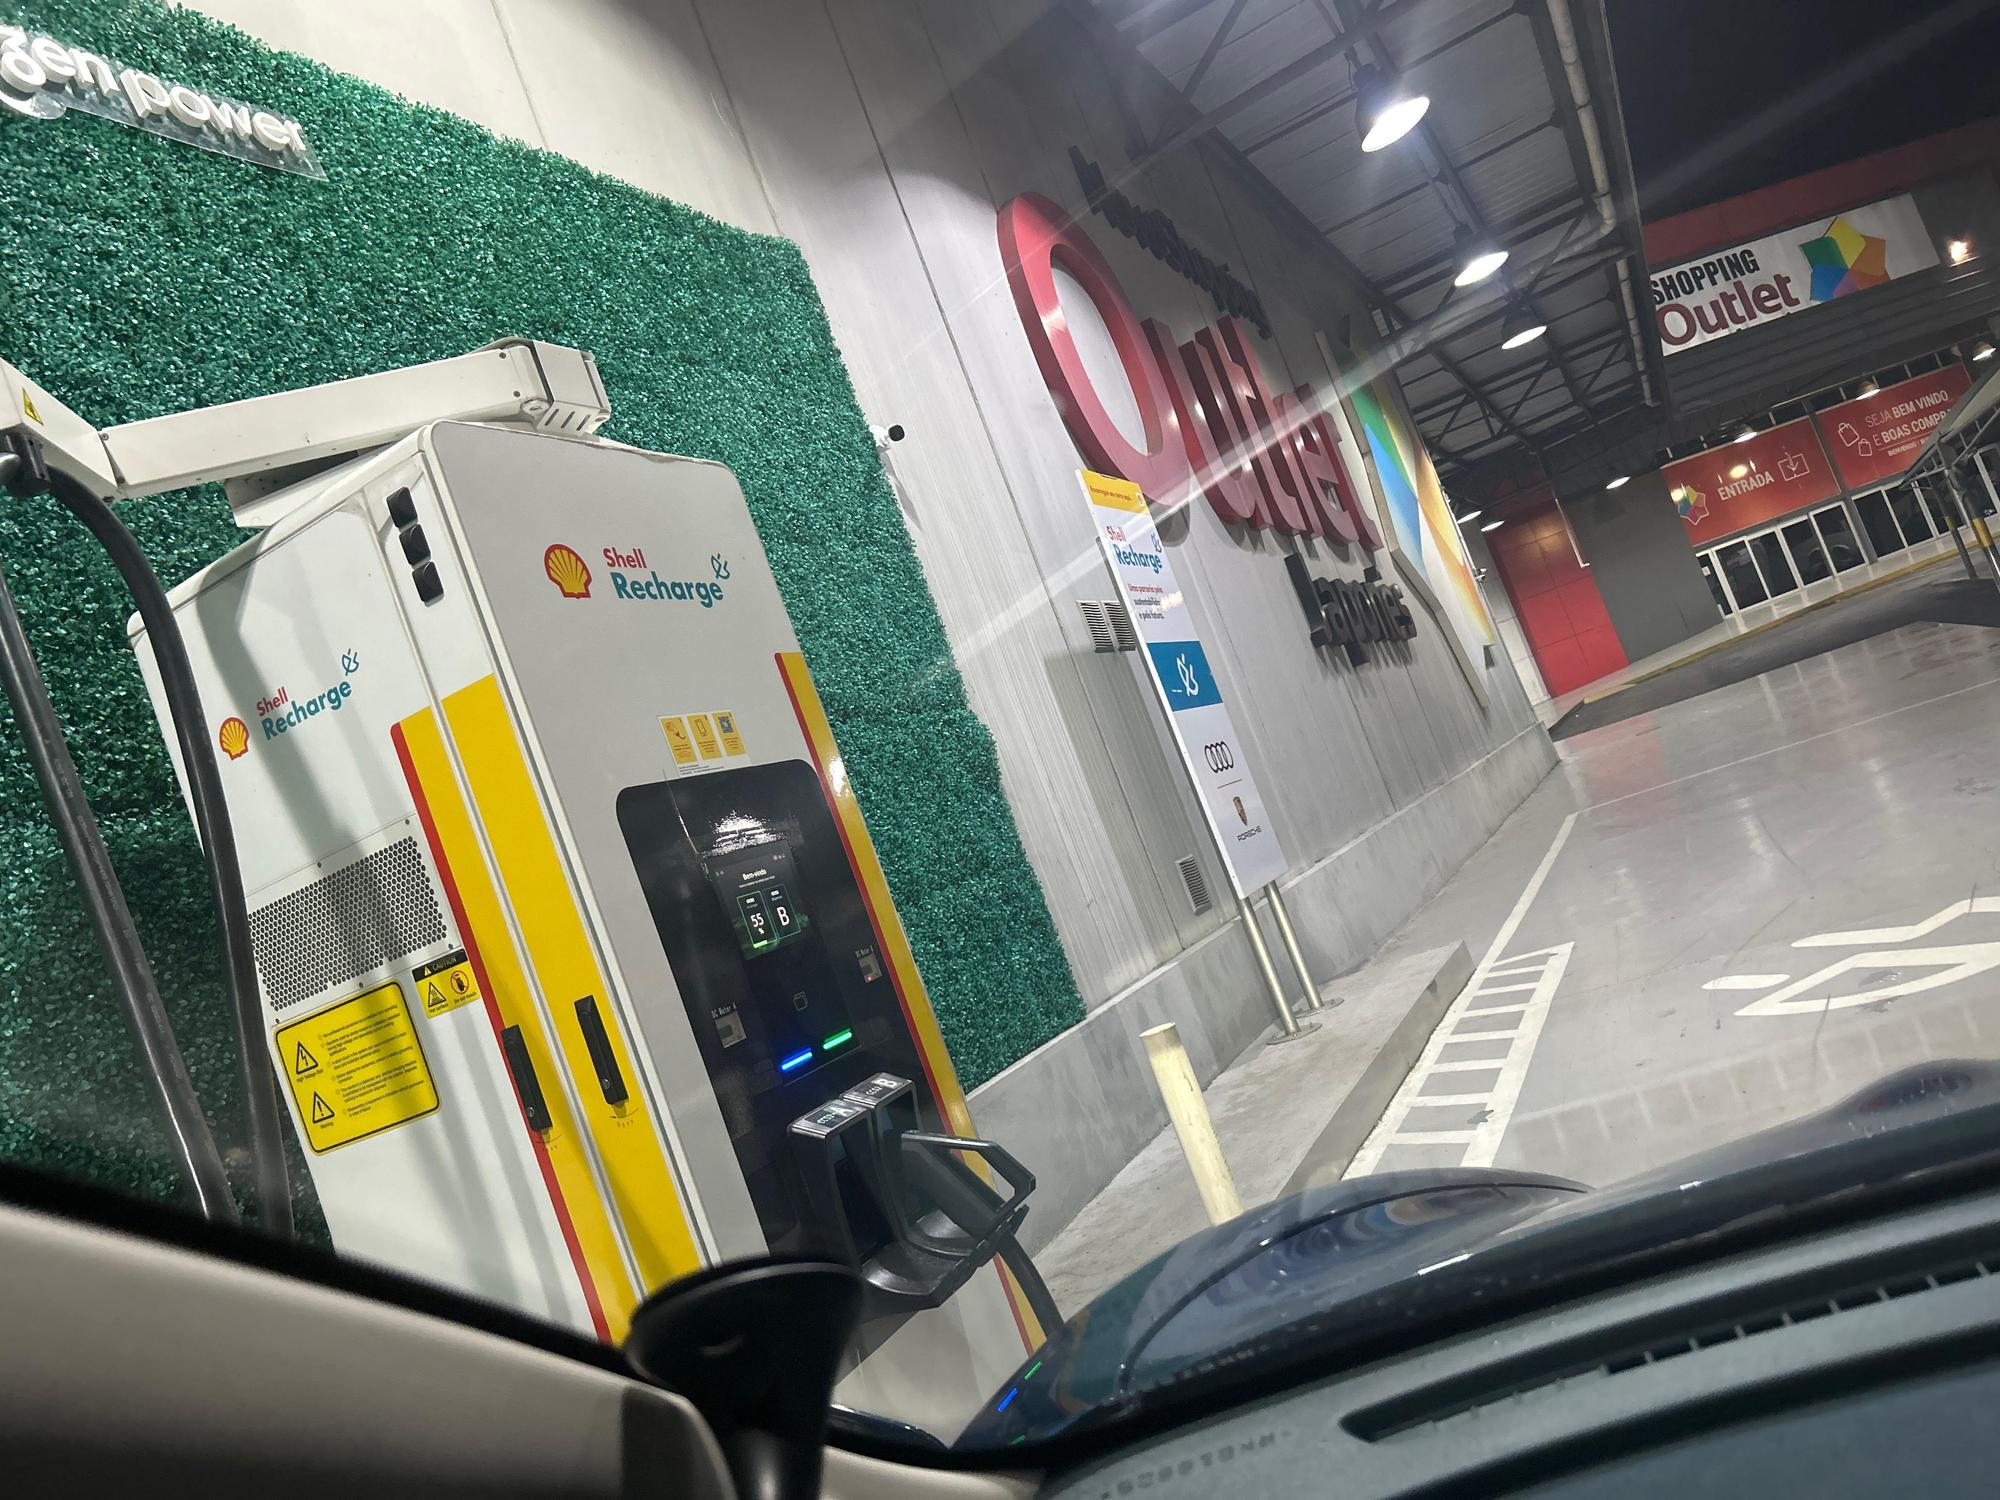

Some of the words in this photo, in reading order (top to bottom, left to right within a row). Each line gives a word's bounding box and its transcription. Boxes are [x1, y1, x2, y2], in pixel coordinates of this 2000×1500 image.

[119, 68, 306, 151] power
[1651, 249, 1760, 306] SHOPPING
[1656, 274, 1800, 346] Outlet
[997, 191, 1385, 550] Outlet
[1865, 409, 1893, 428] SEJA
[1892, 401, 1917, 419] BEM
[1915, 390, 1949, 410] VINDO
[1872, 433, 1882, 446] E
[1881, 423, 1911, 443] BOAS
[1717, 470, 1775, 502] ENTRADA
[1106, 525, 1126, 542] Shell
[603, 547, 647, 569] Shell
[1112, 543, 1163, 574] Recharge
[610, 571, 724, 608] Recharge
[256, 686, 289, 716] Shell
[261, 681, 352, 740] Recharge
[1237, 826, 1262, 840] PORSCHE
[750, 913, 764, 927] 55
[777, 906, 790, 926] B
[432, 956, 457, 971] CAUTION
